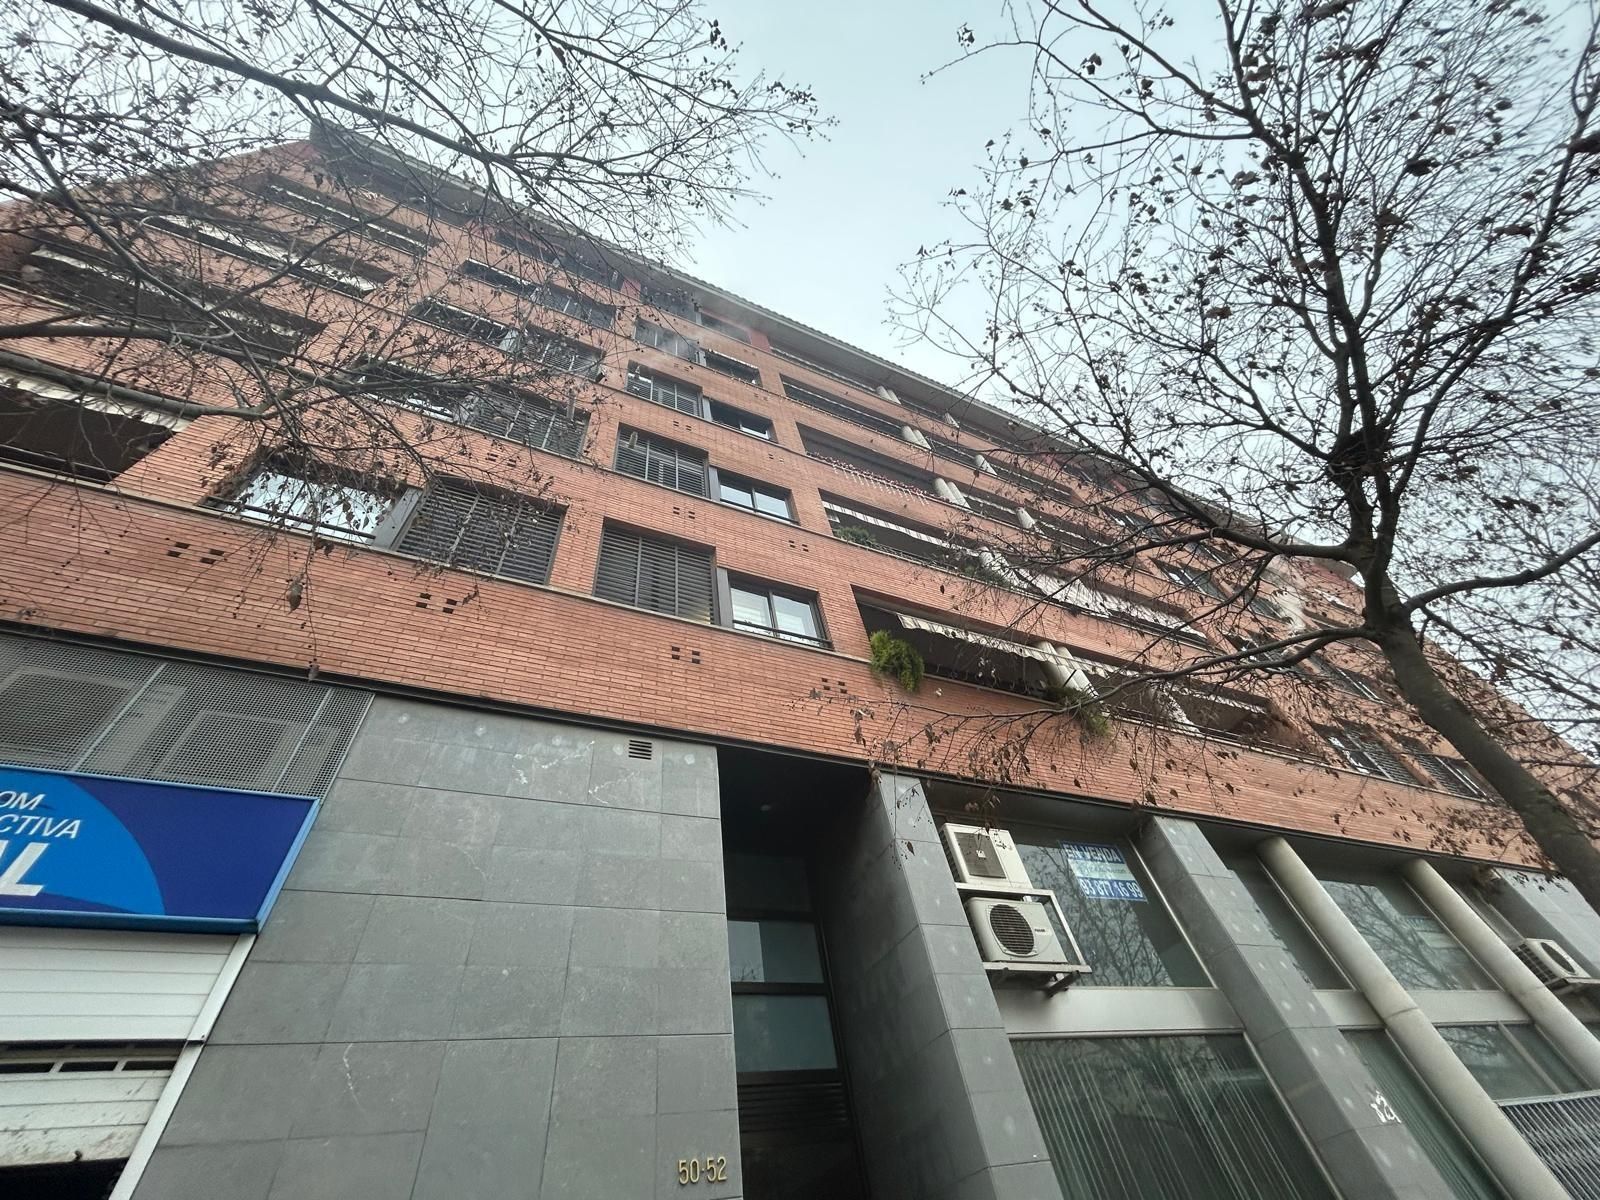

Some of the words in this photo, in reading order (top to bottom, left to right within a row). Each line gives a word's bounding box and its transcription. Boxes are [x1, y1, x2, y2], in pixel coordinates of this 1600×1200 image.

[0, 814, 81, 839] CTIVA
[1063, 844, 1083, 859] EN
[1082, 846, 1121, 862] VENDA
[1080, 879, 1096, 895] 93
[1094, 880, 1115, 896] 877
[1114, 881, 1130, 897] 16
[1126, 882, 1144, 898] 99
